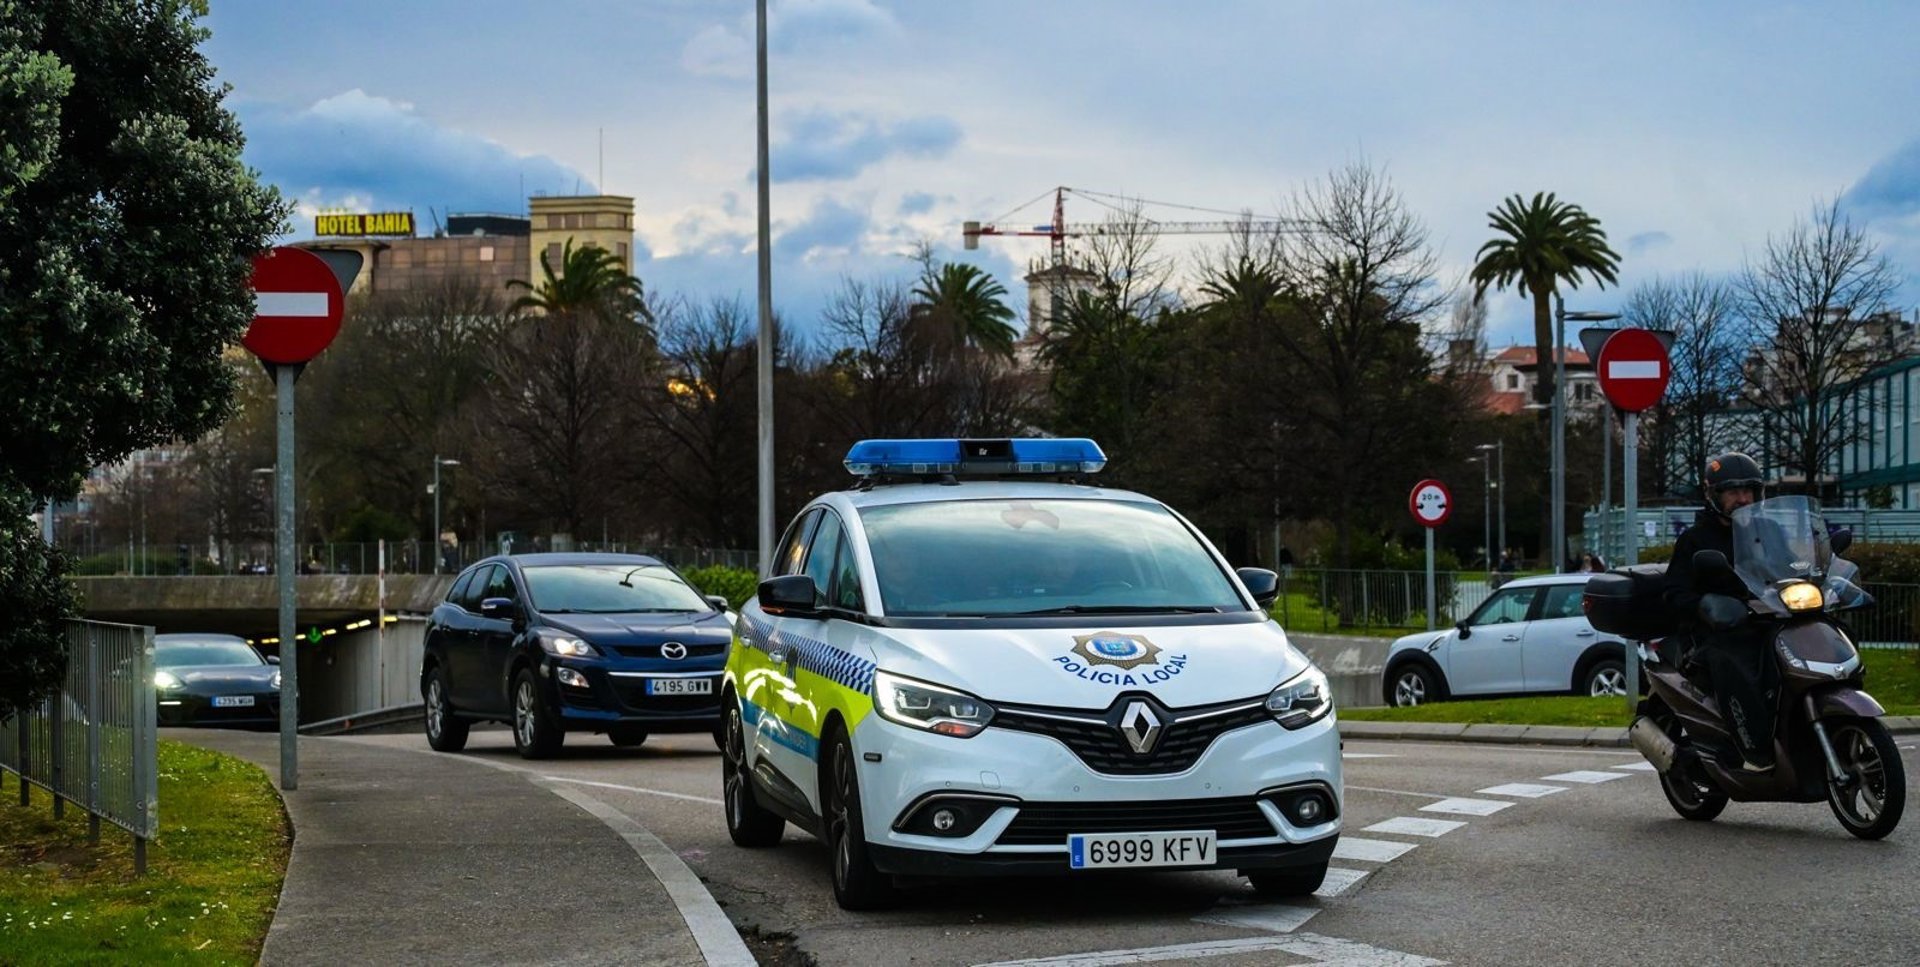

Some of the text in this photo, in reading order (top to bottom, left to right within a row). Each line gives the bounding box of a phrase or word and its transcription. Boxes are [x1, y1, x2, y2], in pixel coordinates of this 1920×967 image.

[317, 213, 411, 235] HOTEL BAHIA
[1053, 654, 1187, 686] POLICIA LOCAL
[653, 680, 684, 693] 4195
[1090, 836, 1209, 864] 6999 KFV
